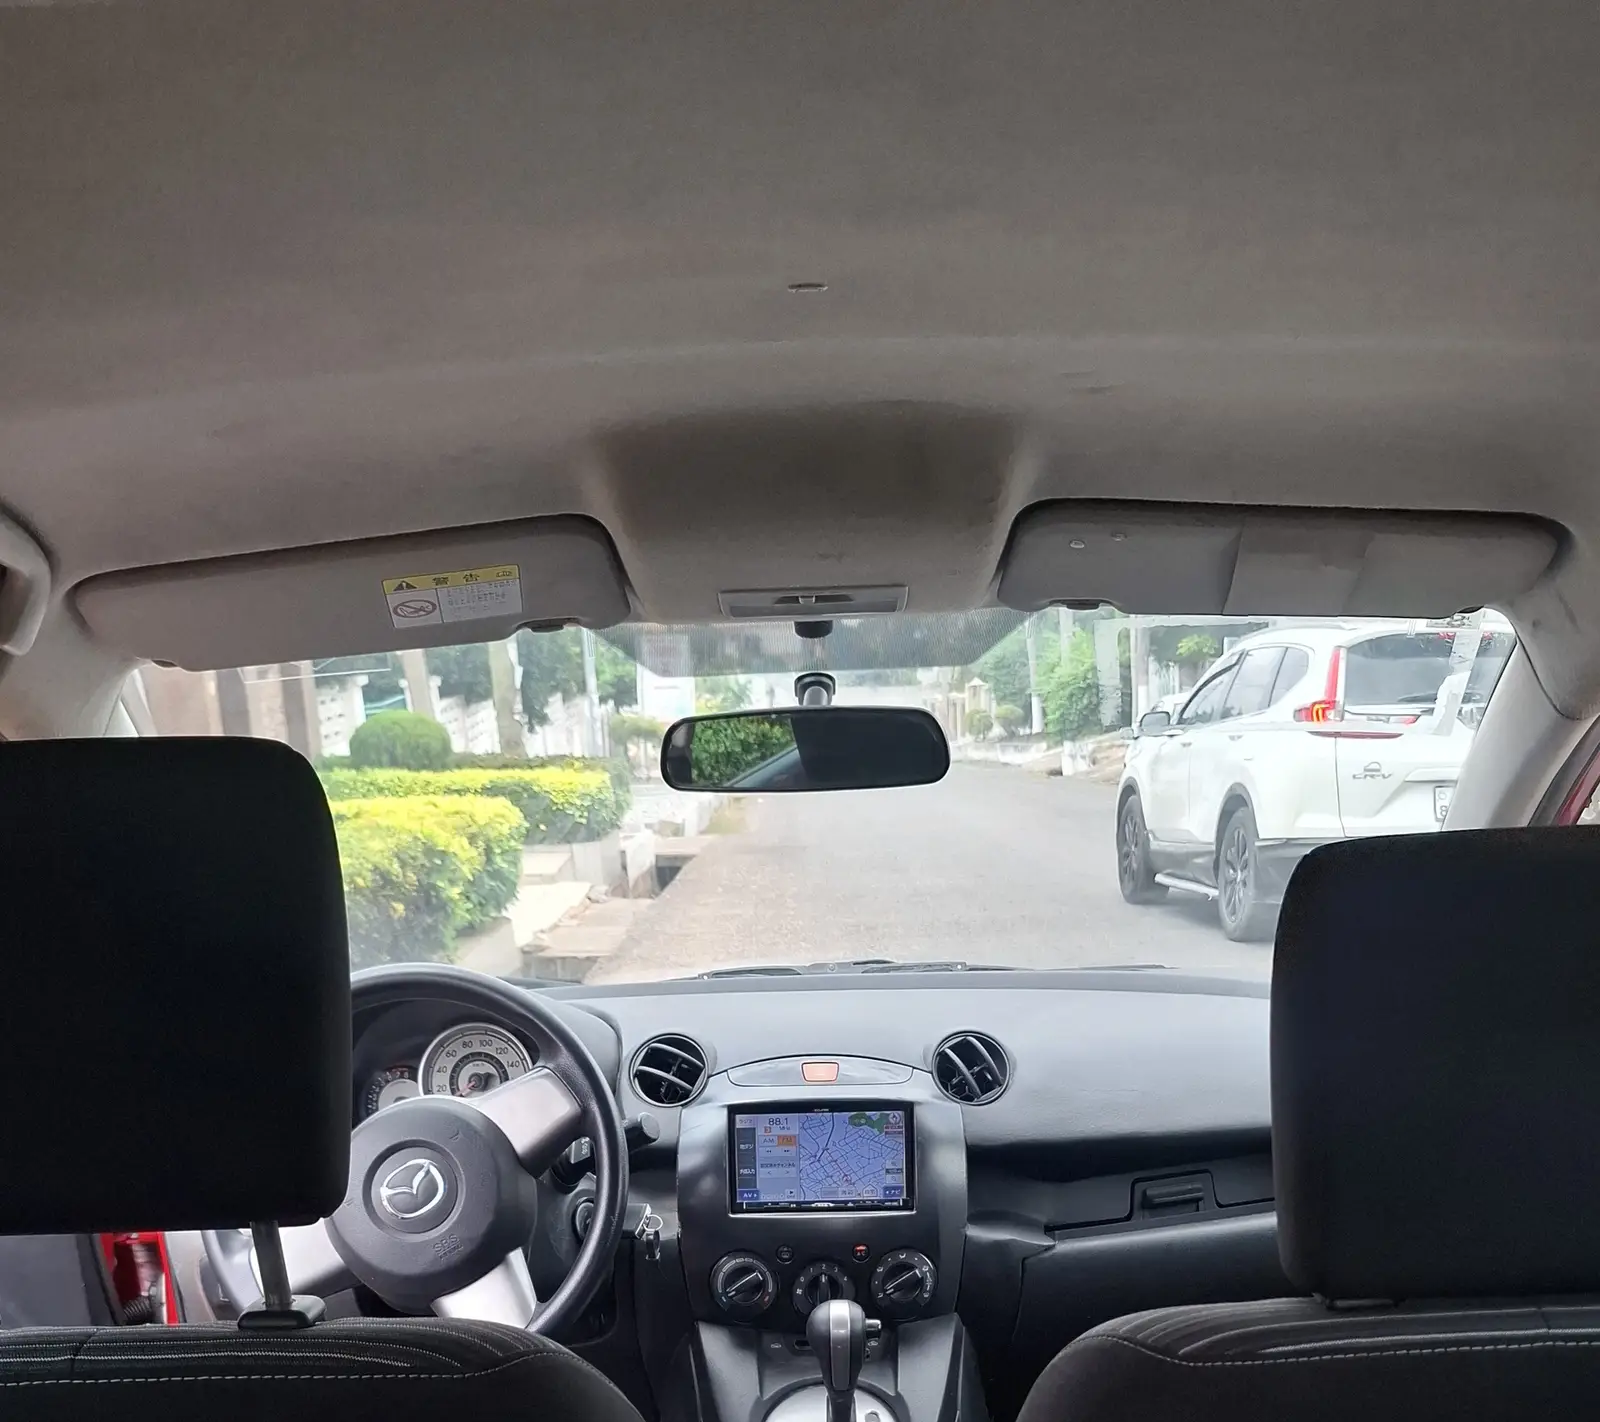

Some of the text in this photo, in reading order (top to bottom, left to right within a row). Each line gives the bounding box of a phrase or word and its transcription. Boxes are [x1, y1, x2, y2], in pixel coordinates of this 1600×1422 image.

[462, 1040, 473, 1049] 80
[479, 1039, 493, 1048] 100
[445, 1049, 457, 1059] 60
[495, 1046, 509, 1056] 120
[506, 1060, 520, 1069] 140
[436, 1065, 447, 1074] 40
[436, 1084, 447, 1093] 20
[768, 1117, 788, 1126] 88.1
